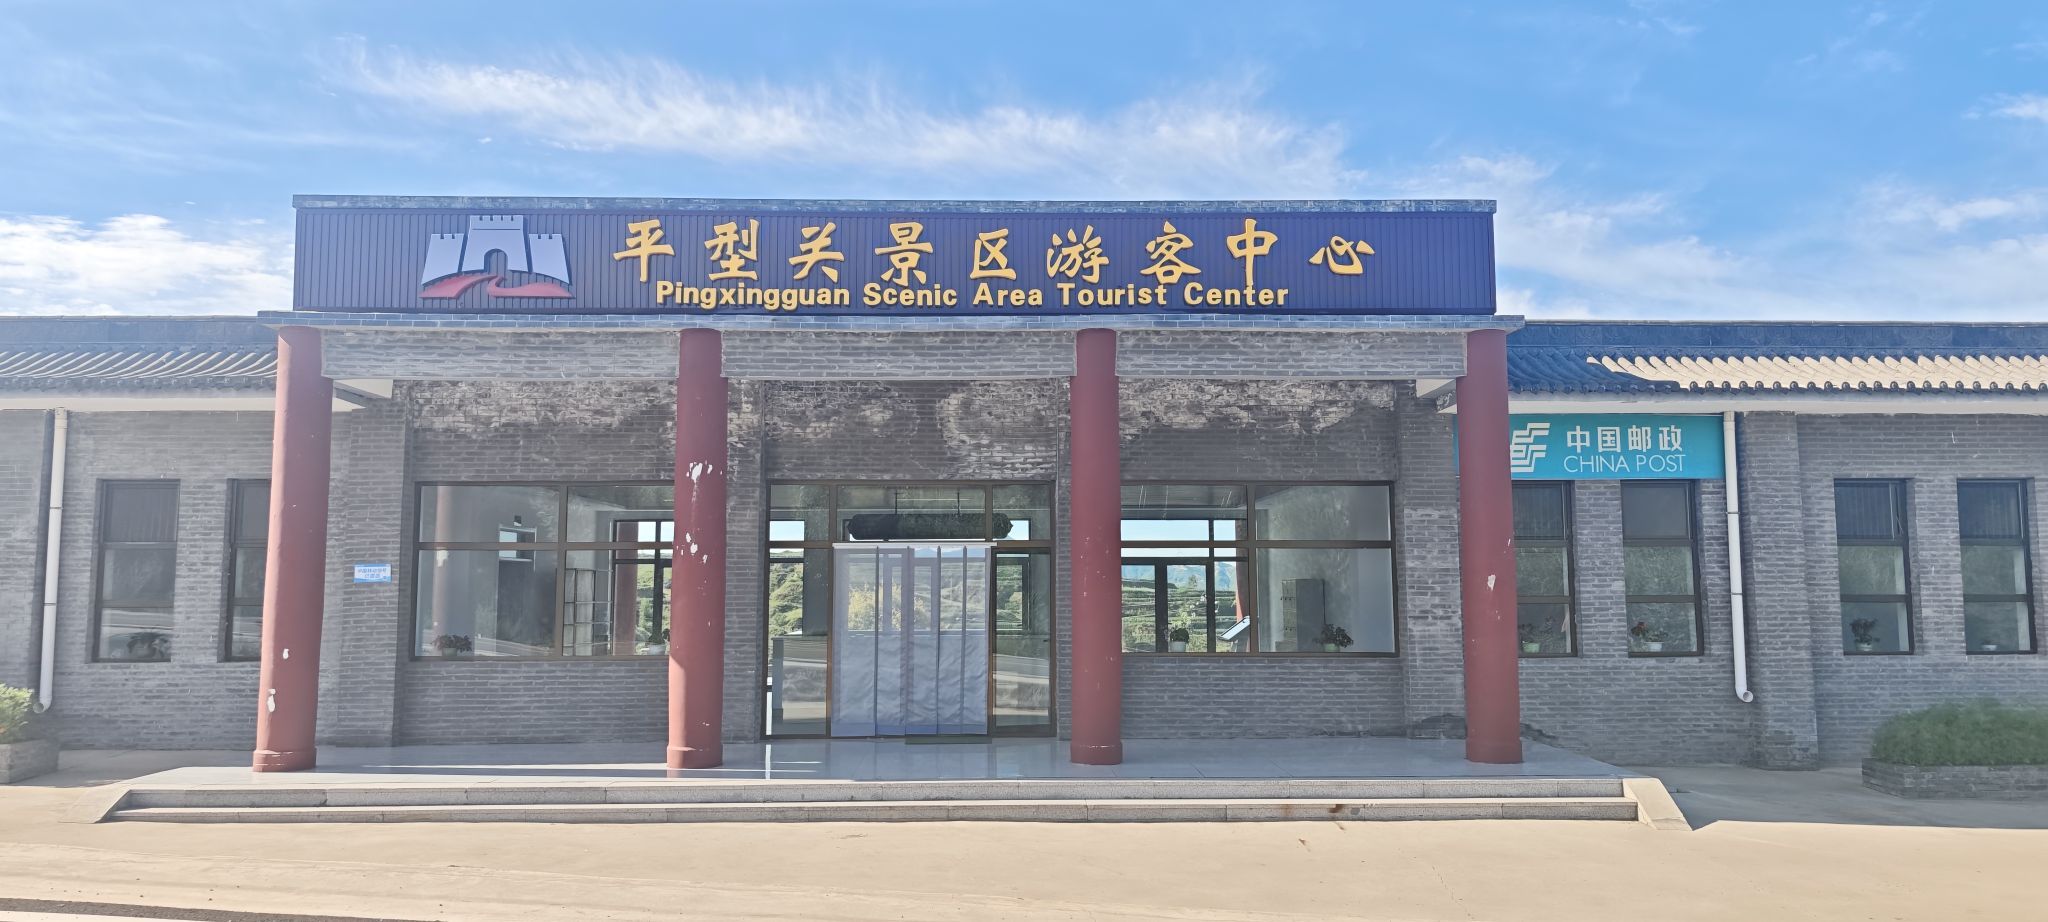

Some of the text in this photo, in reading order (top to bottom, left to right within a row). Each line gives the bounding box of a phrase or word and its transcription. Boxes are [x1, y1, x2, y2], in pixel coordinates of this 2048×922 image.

[613, 218, 1375, 287] 平型关景区游客中心
[656, 281, 1288, 311] Pingxingguan Scenic Area Tourist Center
[1566, 425, 1682, 453] 中国邮政
[1563, 455, 1686, 473] CHINA POST
